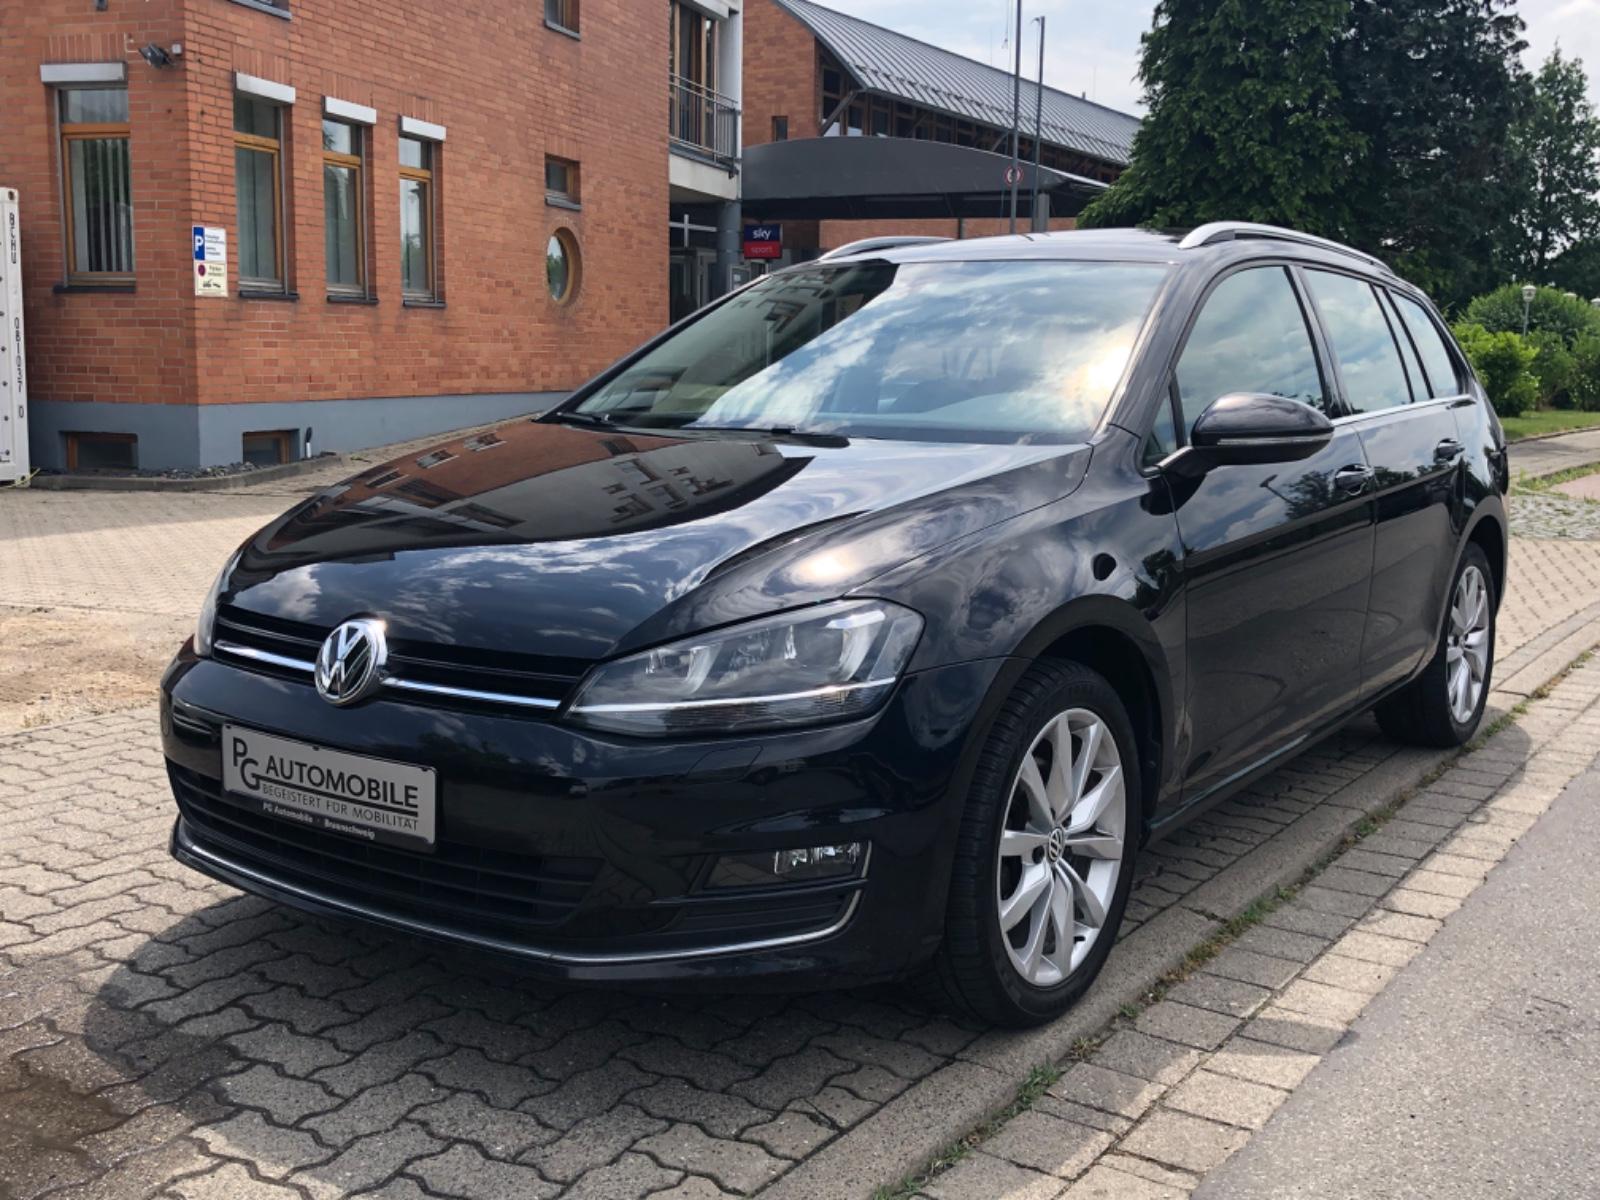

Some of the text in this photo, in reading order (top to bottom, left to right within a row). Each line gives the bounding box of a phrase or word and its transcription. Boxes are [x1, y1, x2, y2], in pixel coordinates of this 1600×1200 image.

[752, 228, 771, 240] sky
[265, 754, 419, 809] AUTOMOBILE
[262, 783, 320, 809] BEGEISTERT
[326, 799, 348, 815] FÜR
